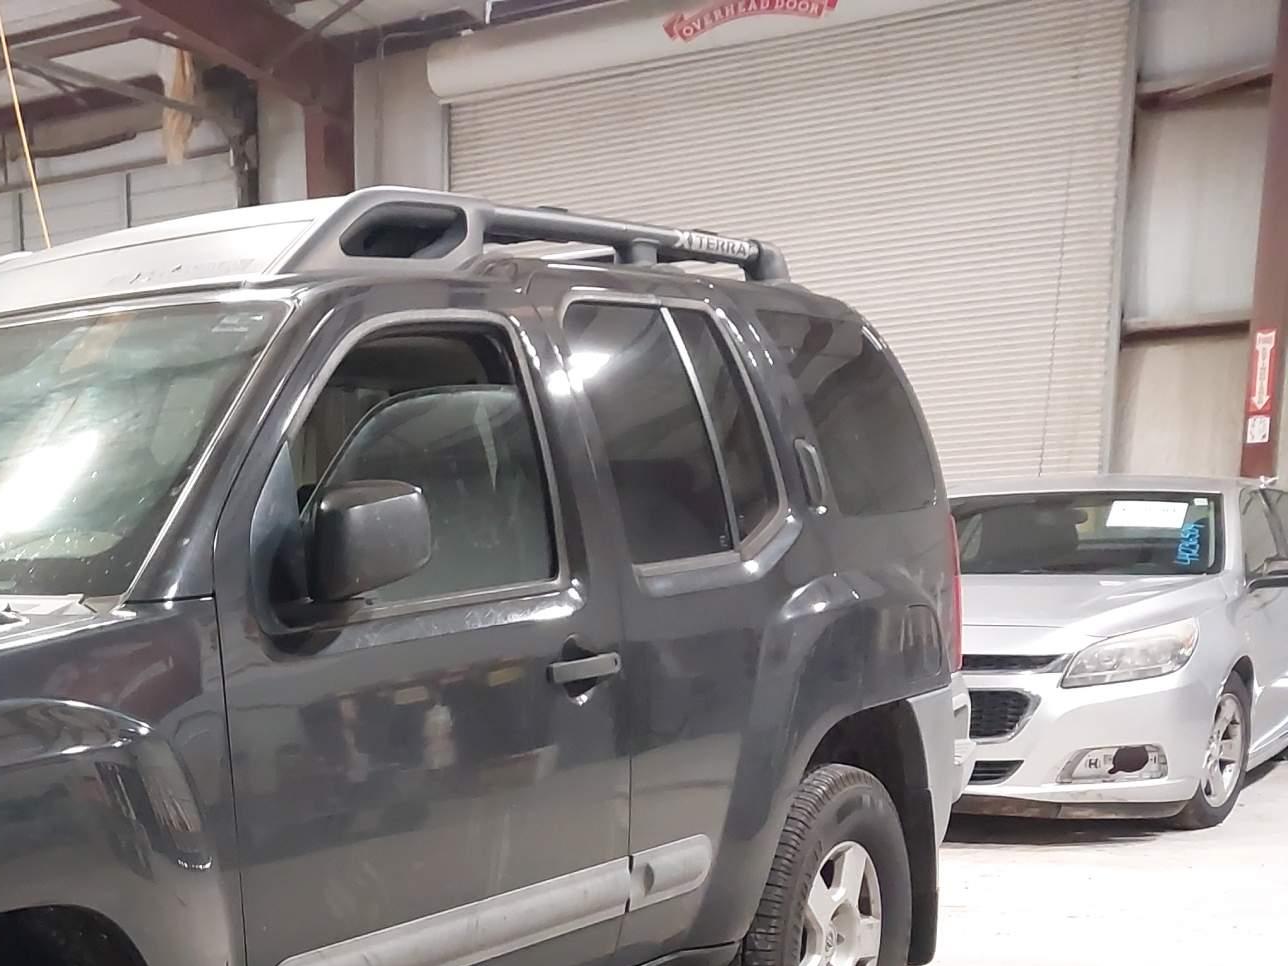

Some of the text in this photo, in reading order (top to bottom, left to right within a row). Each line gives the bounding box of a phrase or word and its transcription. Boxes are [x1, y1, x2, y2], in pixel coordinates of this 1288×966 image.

[682, 0, 820, 37] OVERHEAD DOOR
[674, 229, 748, 258] XTERRA
